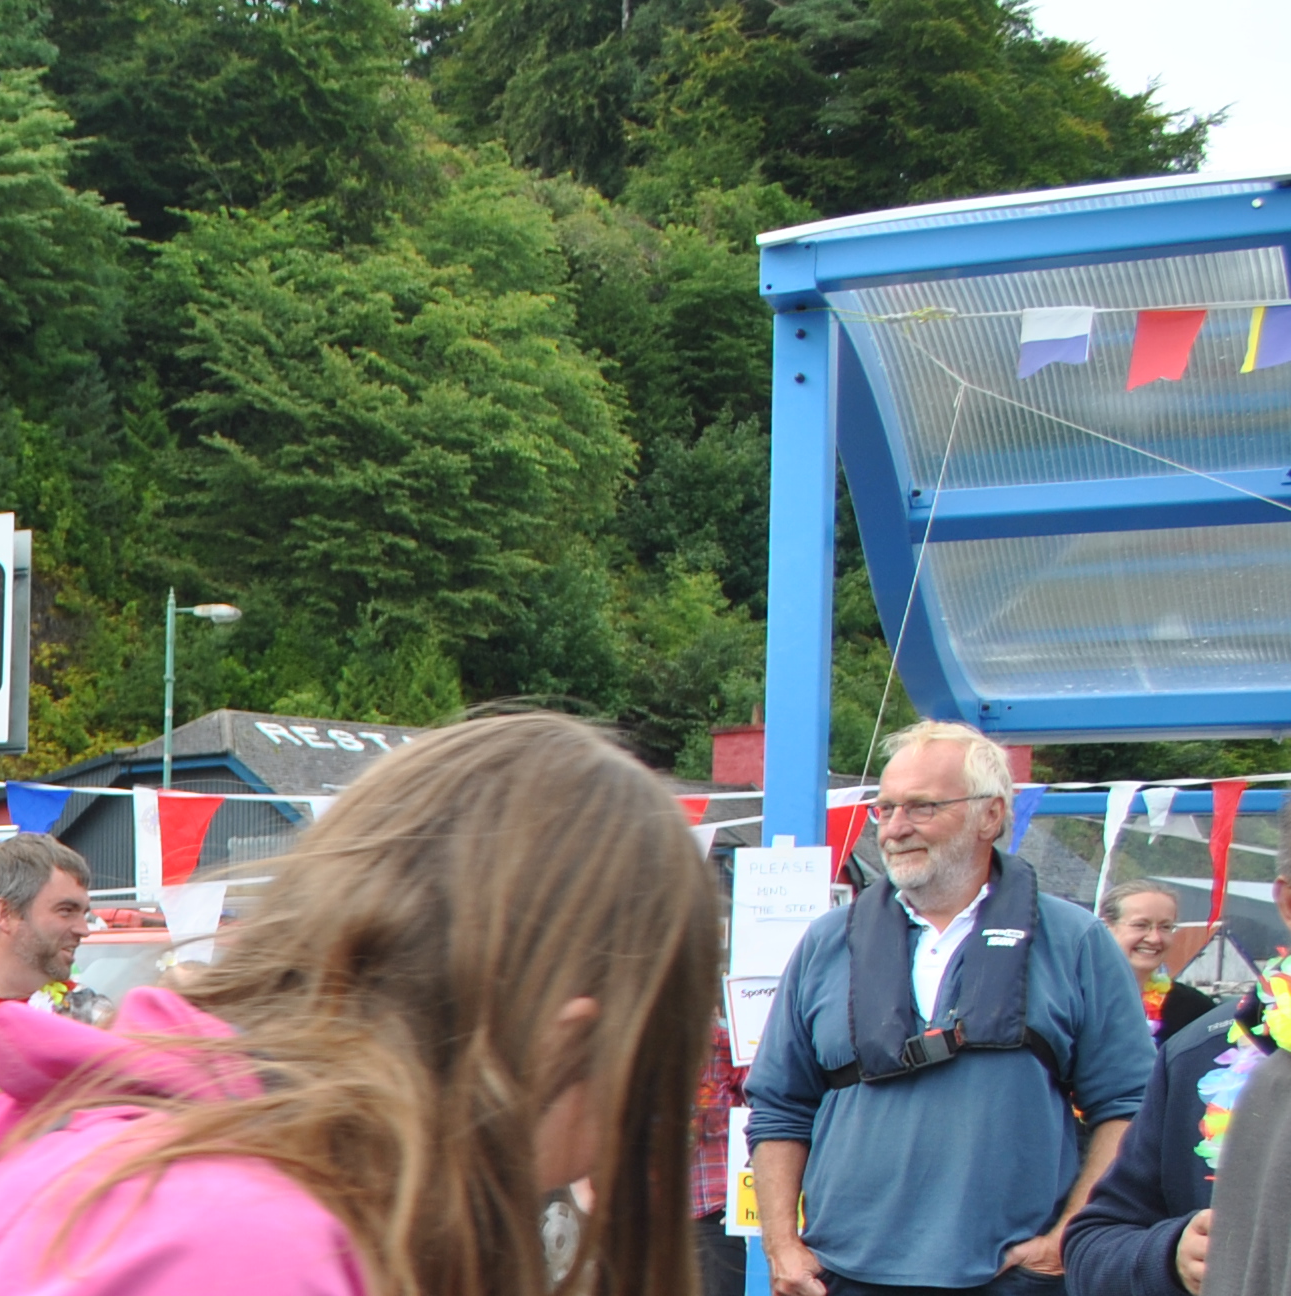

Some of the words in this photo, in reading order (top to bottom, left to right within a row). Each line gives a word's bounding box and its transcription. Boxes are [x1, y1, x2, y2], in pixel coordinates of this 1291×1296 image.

[254, 721, 413, 752] REST
[749, 861, 815, 875] PLEASE
[757, 886, 787, 896] MIND
[751, 905, 774, 915] THE
[785, 903, 816, 914] STEP
